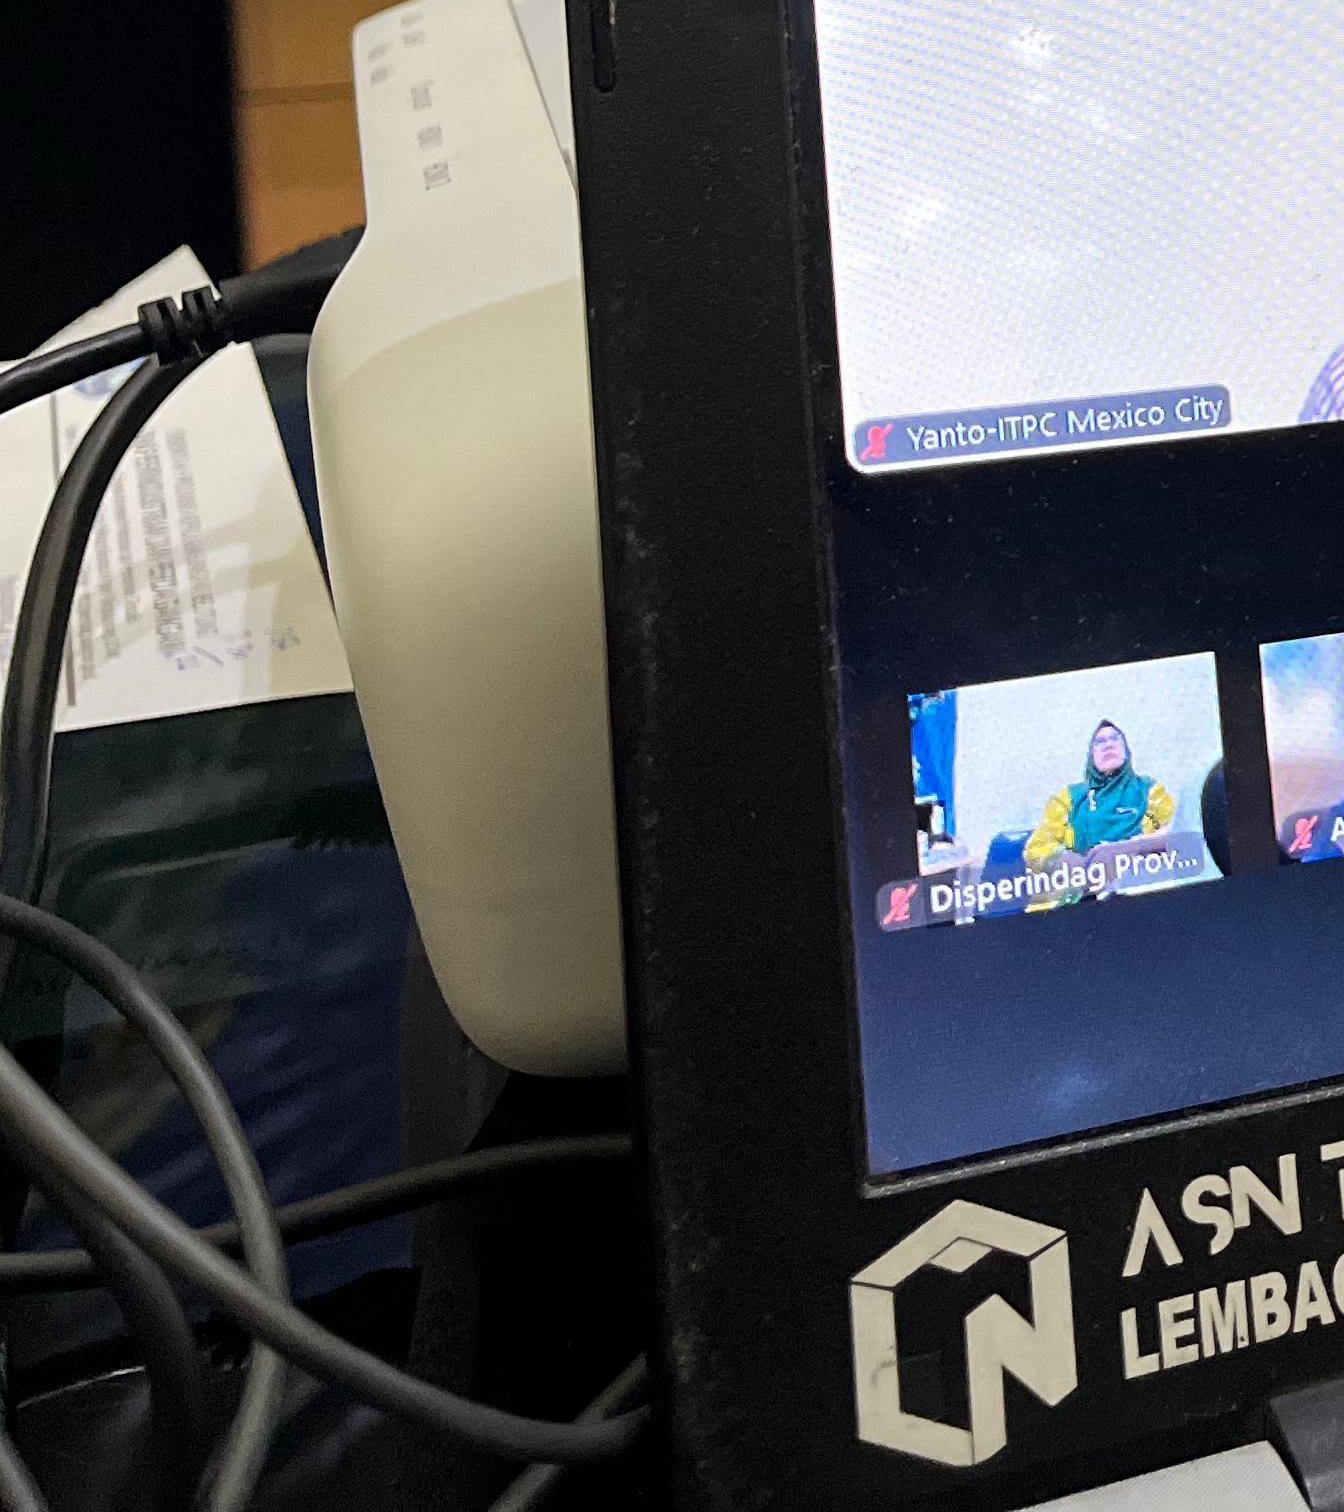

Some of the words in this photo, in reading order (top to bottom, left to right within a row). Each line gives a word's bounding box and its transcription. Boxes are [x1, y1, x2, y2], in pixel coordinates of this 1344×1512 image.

[906, 411, 1059, 452] Yanto-ITPC
[1066, 403, 1166, 434] Mexico
[1174, 395, 1225, 428] City
[930, 856, 1107, 915] Disperindag
[1114, 846, 1200, 880] Prov...
[1121, 1153, 1303, 1279] ASN
